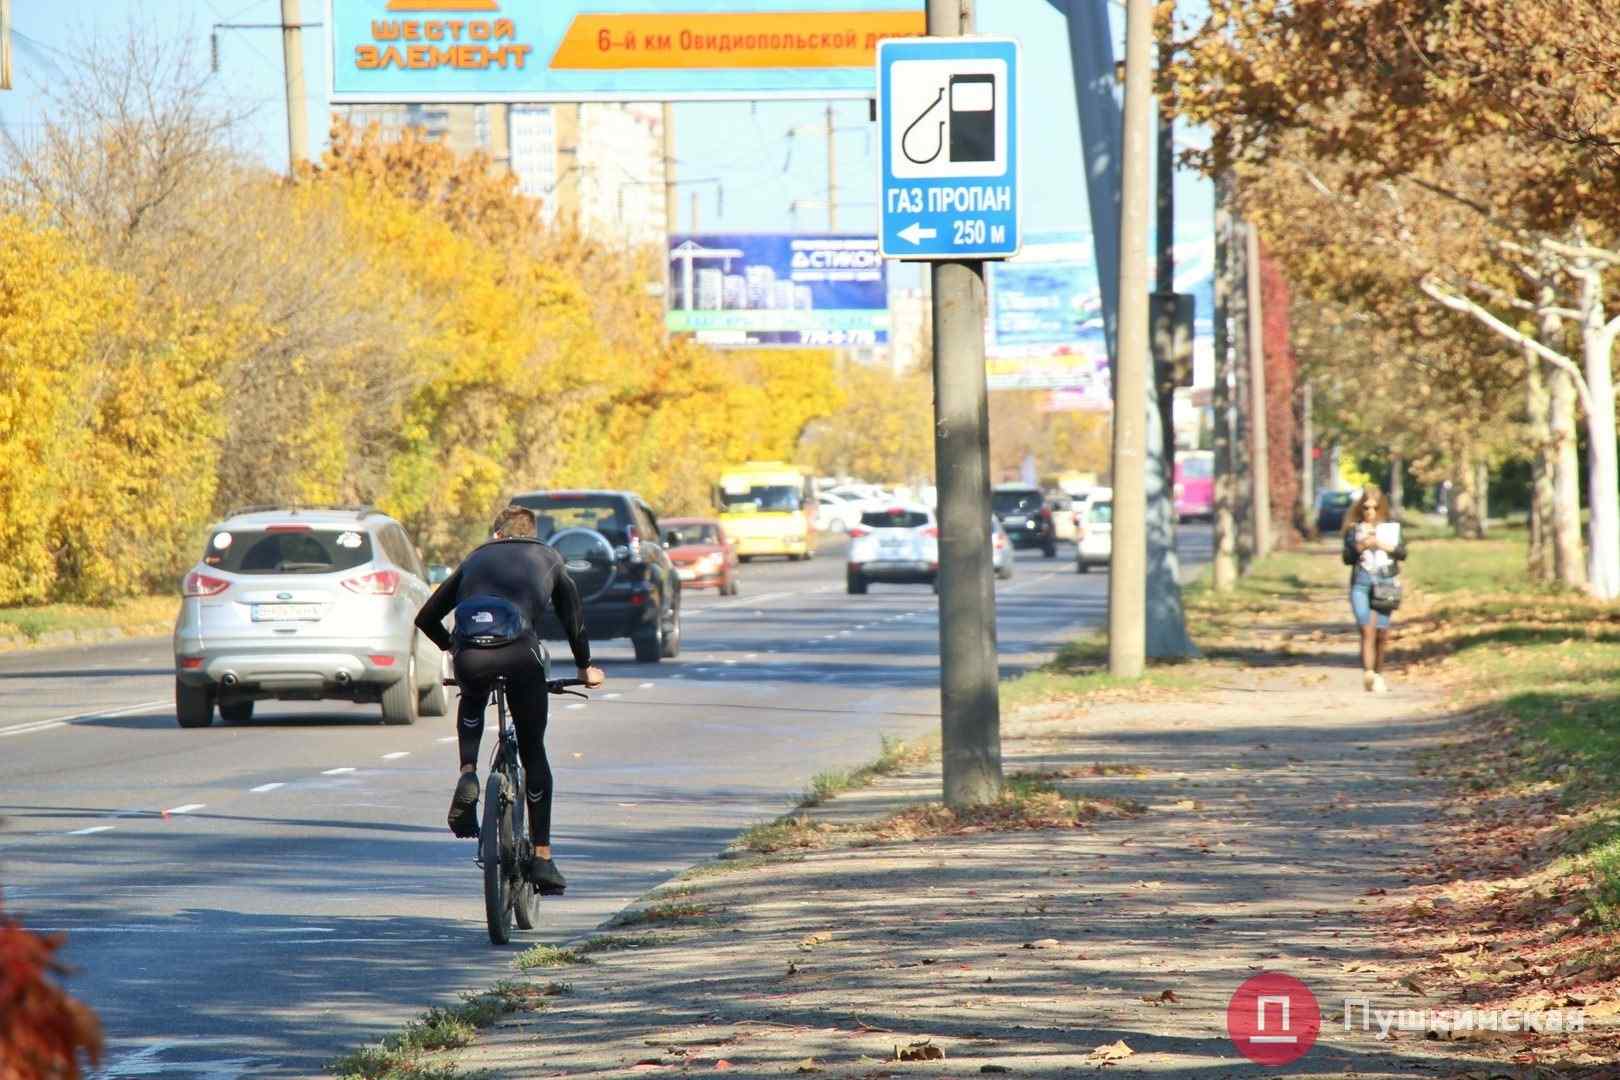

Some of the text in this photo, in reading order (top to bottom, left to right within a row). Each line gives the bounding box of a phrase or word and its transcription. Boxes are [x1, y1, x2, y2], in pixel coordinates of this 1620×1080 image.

[371, 18, 516, 41] ШЕСТОЙ
[645, 34, 672, 49] км
[680, 27, 857, 52] Овидиопольской
[355, 44, 534, 70] ЭЛЕМЕНТ
[887, 186, 1011, 213] ГАЗ ПРОПАН
[953, 220, 1006, 244] 250 м
